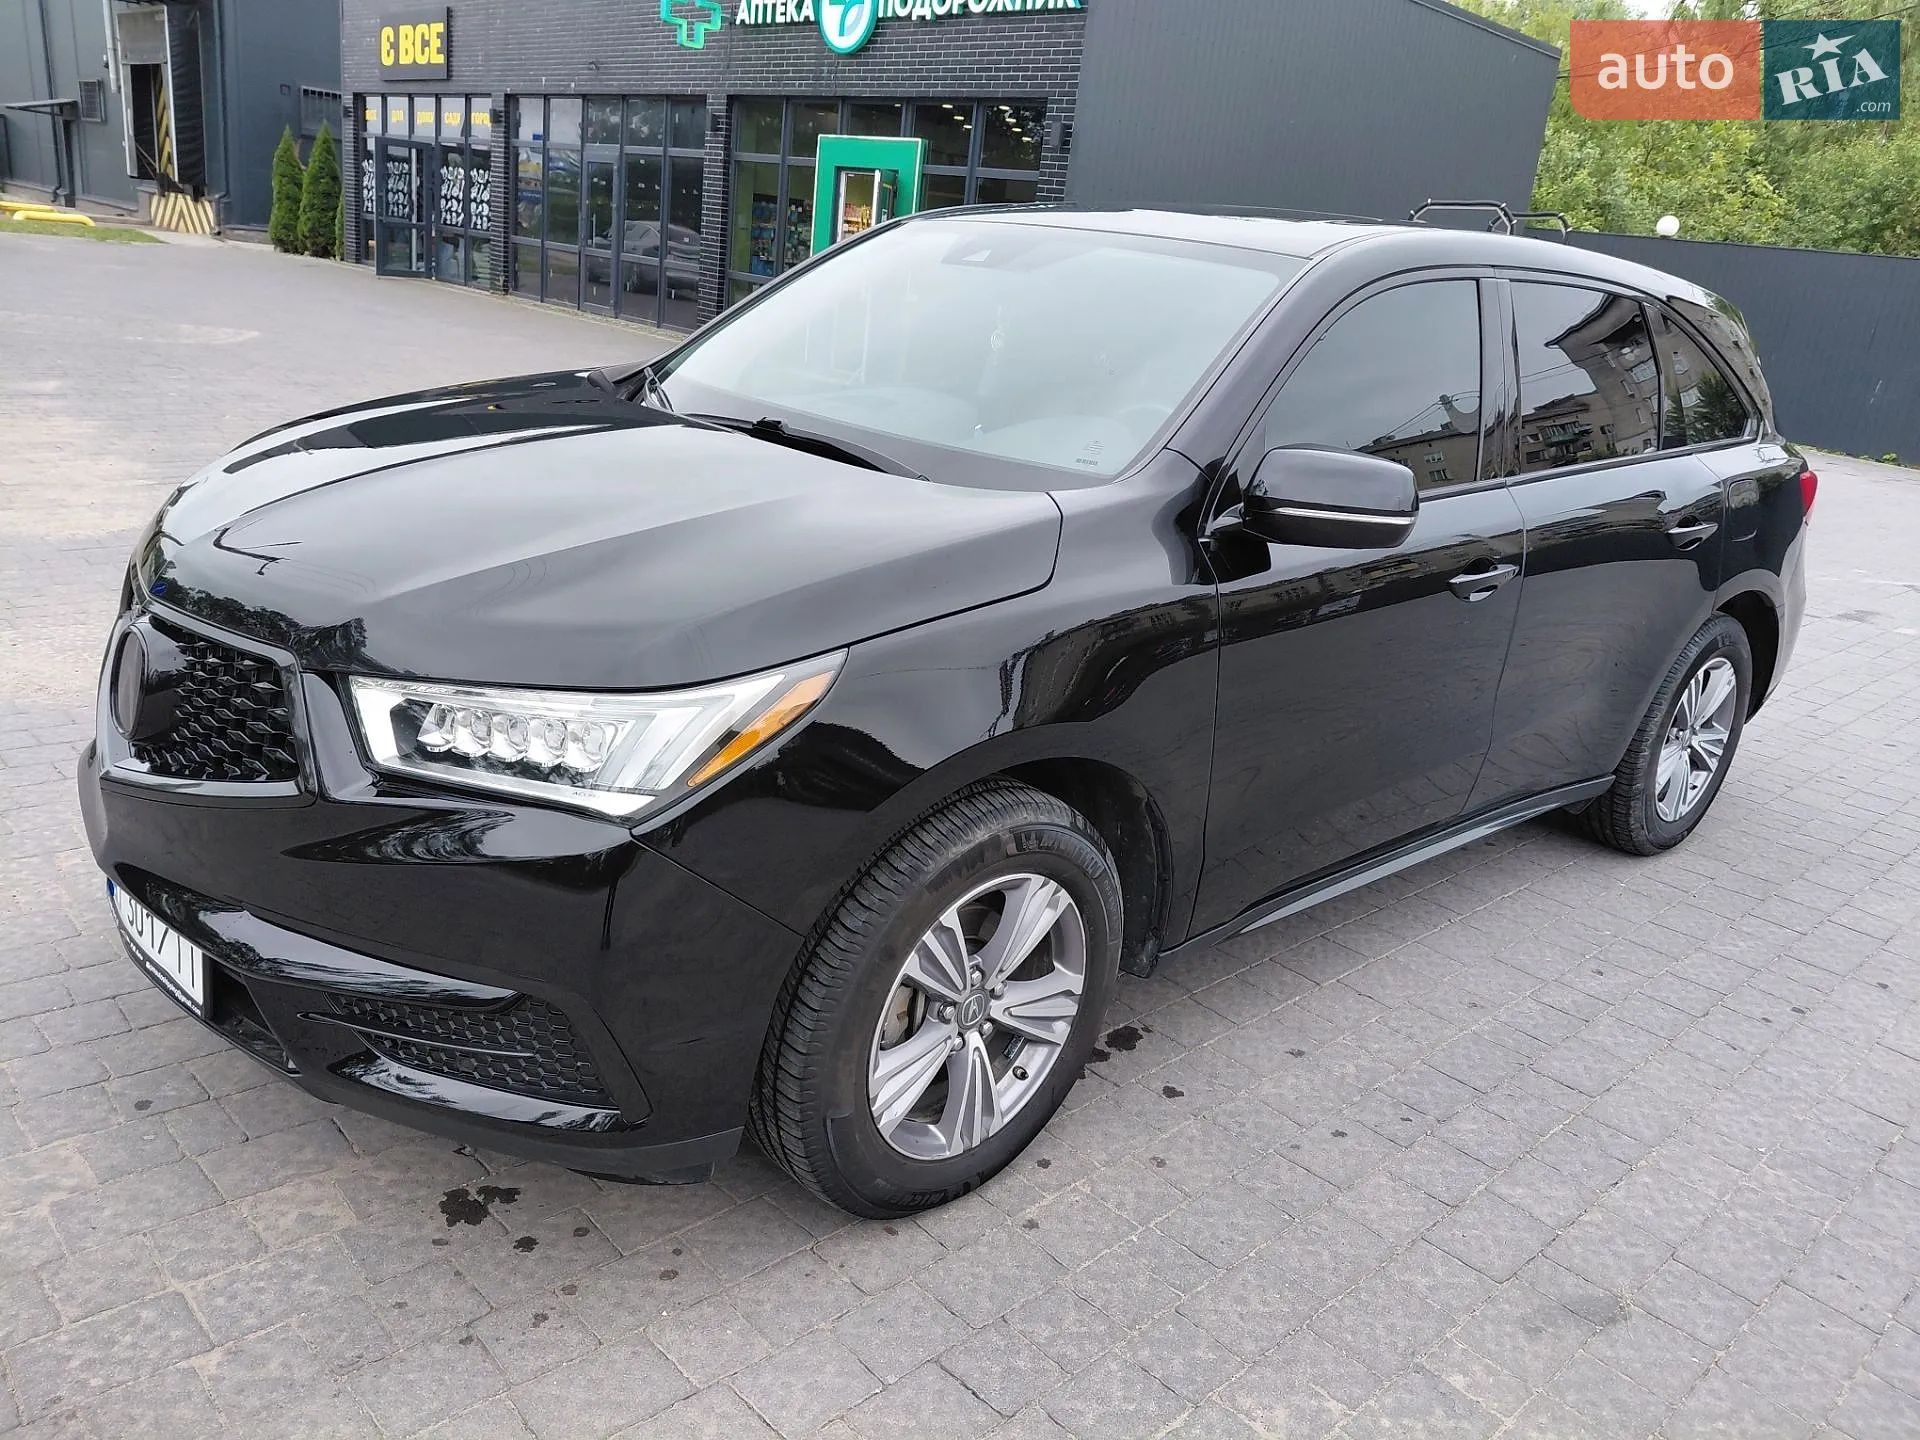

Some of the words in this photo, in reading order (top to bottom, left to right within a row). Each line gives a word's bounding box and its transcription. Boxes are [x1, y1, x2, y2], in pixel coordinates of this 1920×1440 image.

[735, 0, 815, 25] АПТЕКА
[381, 26, 394, 66] Є
[399, 22, 444, 64] ВСЕ
